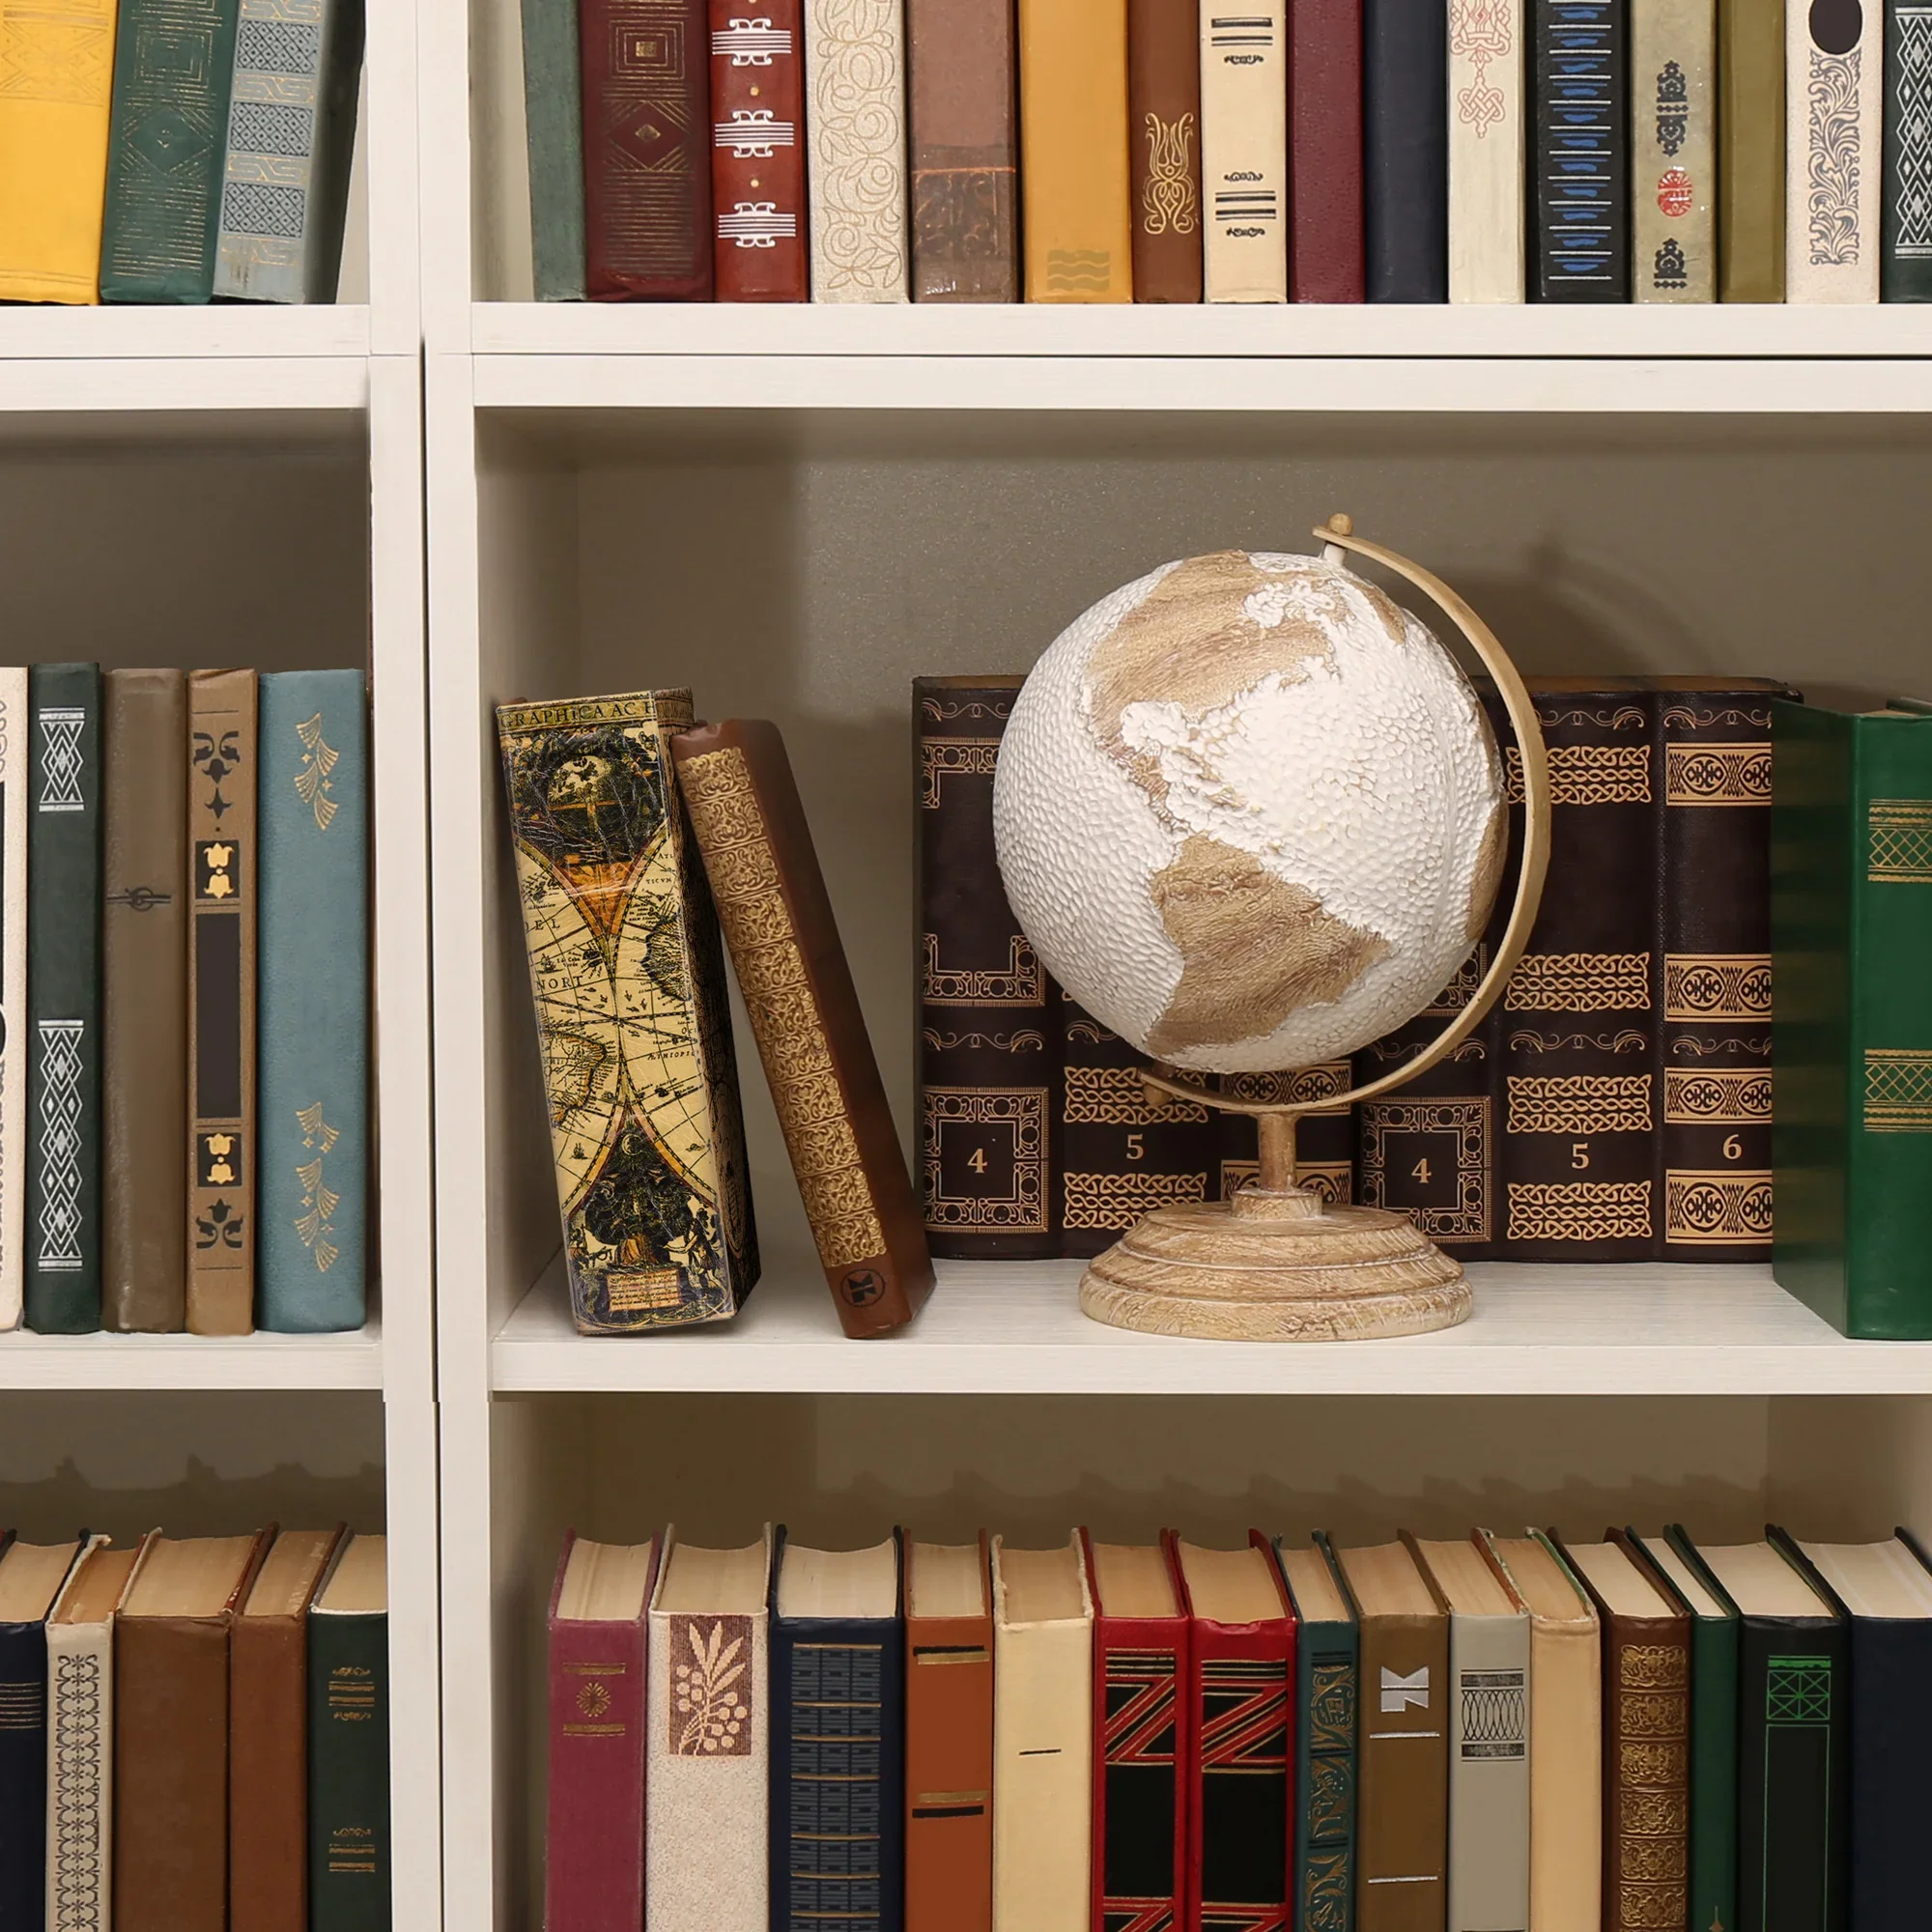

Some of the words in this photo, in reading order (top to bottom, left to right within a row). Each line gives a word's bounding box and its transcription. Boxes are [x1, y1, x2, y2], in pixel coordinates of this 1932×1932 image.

[500, 704, 609, 728] GRAPHICA
[611, 701, 637, 718] AC
[536, 975, 583, 991] NORT
[1127, 1135, 1143, 1159] 5
[1572, 1143, 1589, 1169] 5
[1723, 1134, 1742, 1159] 6
[968, 1149, 987, 1173] 4
[1412, 1159, 1431, 1182] 4
